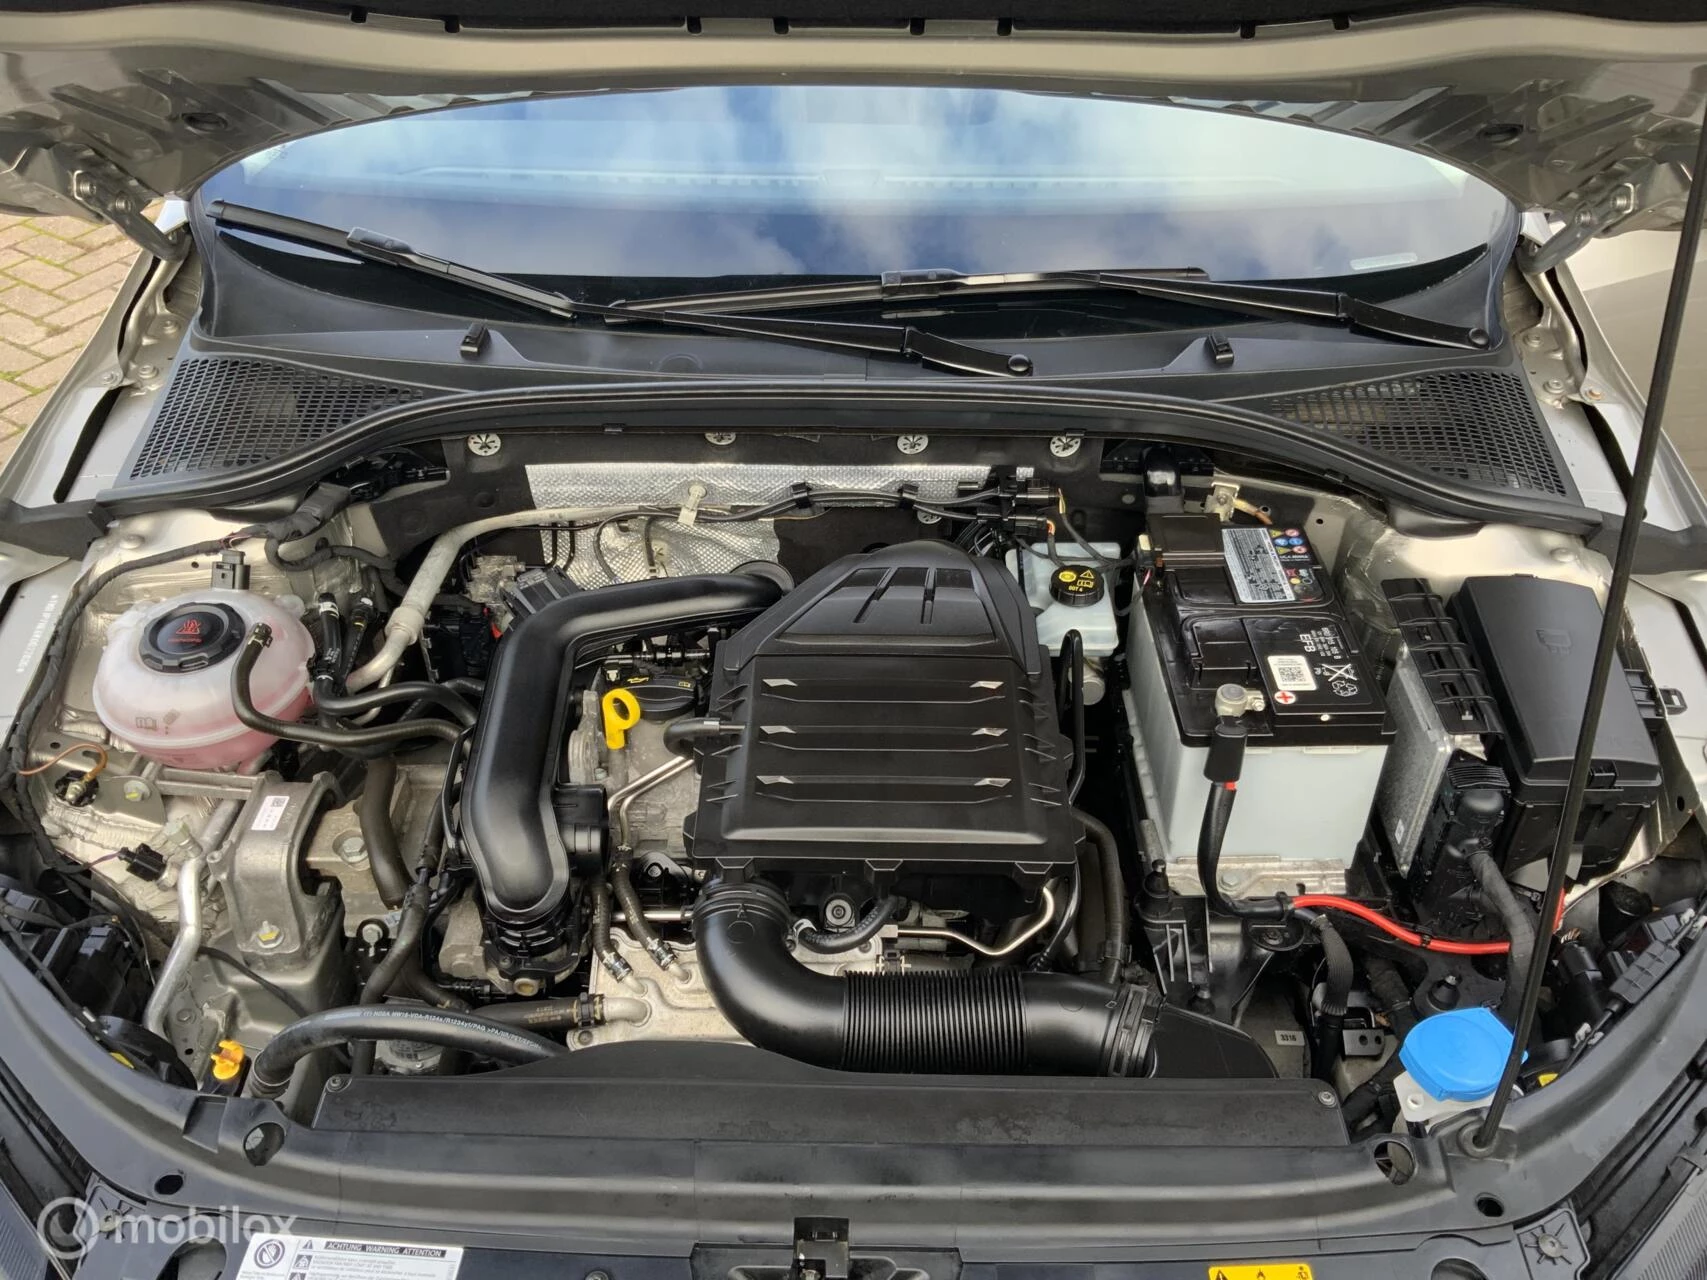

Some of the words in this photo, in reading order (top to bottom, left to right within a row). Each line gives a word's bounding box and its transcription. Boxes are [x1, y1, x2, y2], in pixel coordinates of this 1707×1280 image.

[1299, 634, 1316, 652] EFB
[326, 1241, 362, 1251] ACHTUNG
[365, 1244, 400, 1255] WARNING
[401, 1247, 441, 1258] ATTENTION
